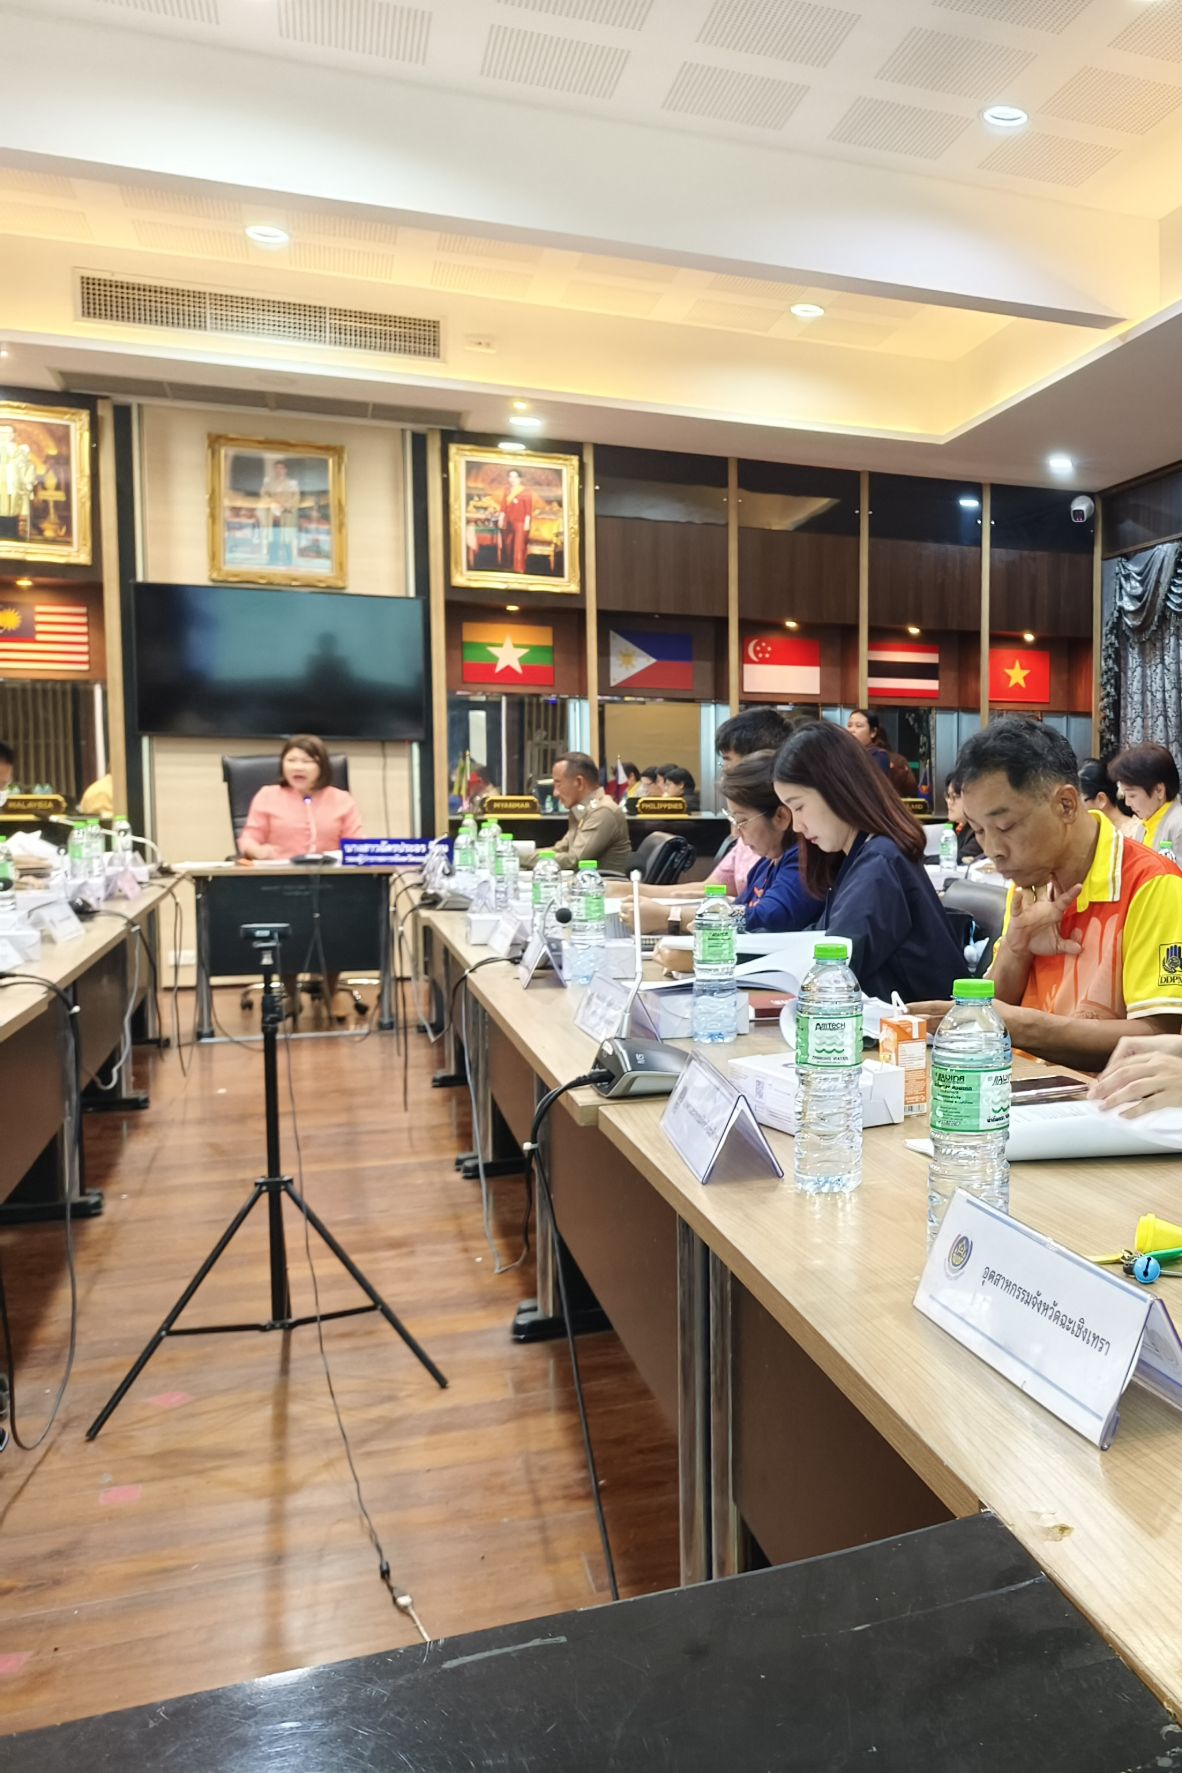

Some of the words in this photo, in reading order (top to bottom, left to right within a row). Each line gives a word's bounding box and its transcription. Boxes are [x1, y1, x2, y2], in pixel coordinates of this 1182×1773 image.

[981, 1266, 1111, 1356] อุตสาหกรรมจังหวัดฉะเชิงเทรา
